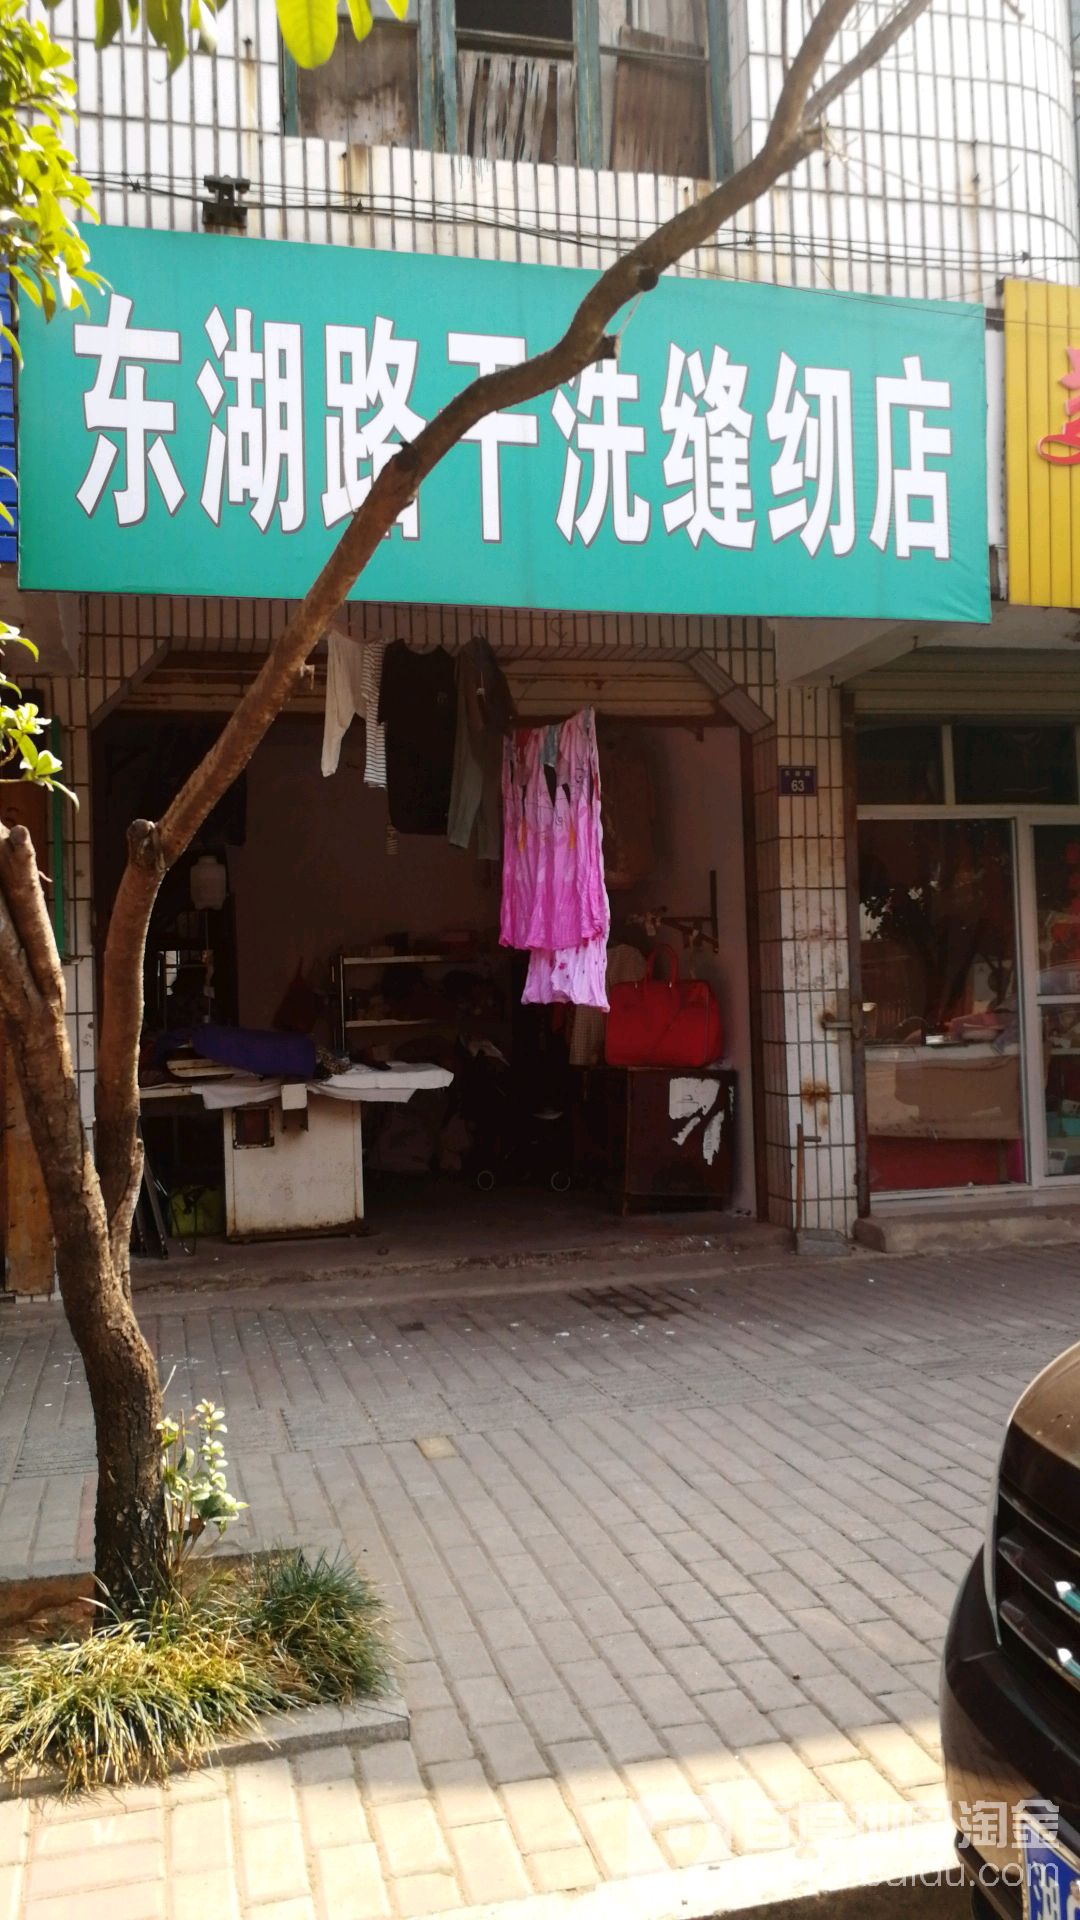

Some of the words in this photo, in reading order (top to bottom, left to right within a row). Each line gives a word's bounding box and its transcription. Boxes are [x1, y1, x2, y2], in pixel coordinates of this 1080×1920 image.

[73, 291, 952, 560] 东湖路干洗缝纫店
[791, 779, 805, 792] 63
